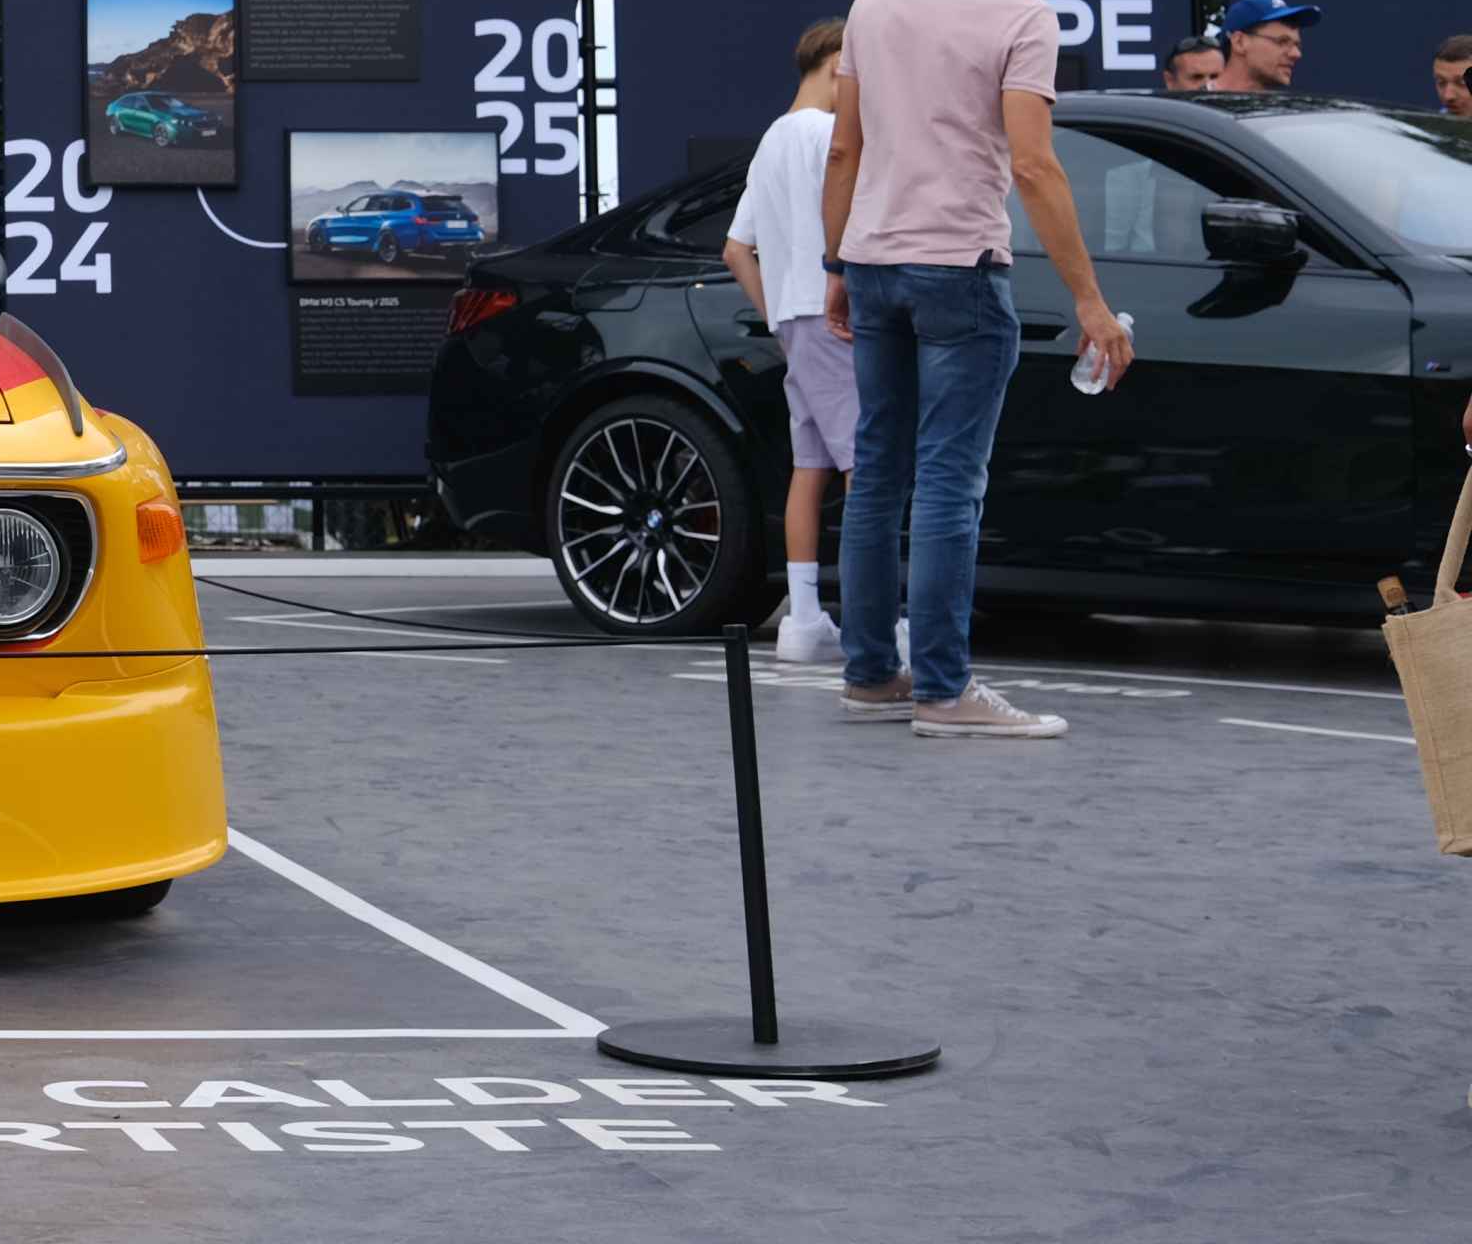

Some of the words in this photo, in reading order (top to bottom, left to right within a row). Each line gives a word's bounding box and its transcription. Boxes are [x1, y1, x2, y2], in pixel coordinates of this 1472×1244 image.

[474, 18, 581, 93] 20
[4, 138, 113, 213] 20
[476, 100, 580, 176] 25
[6, 220, 112, 295] 24
[299, 297, 320, 307] BMW
[346, 297, 374, 308] Touring
[42, 1076, 886, 1108] CALDER
